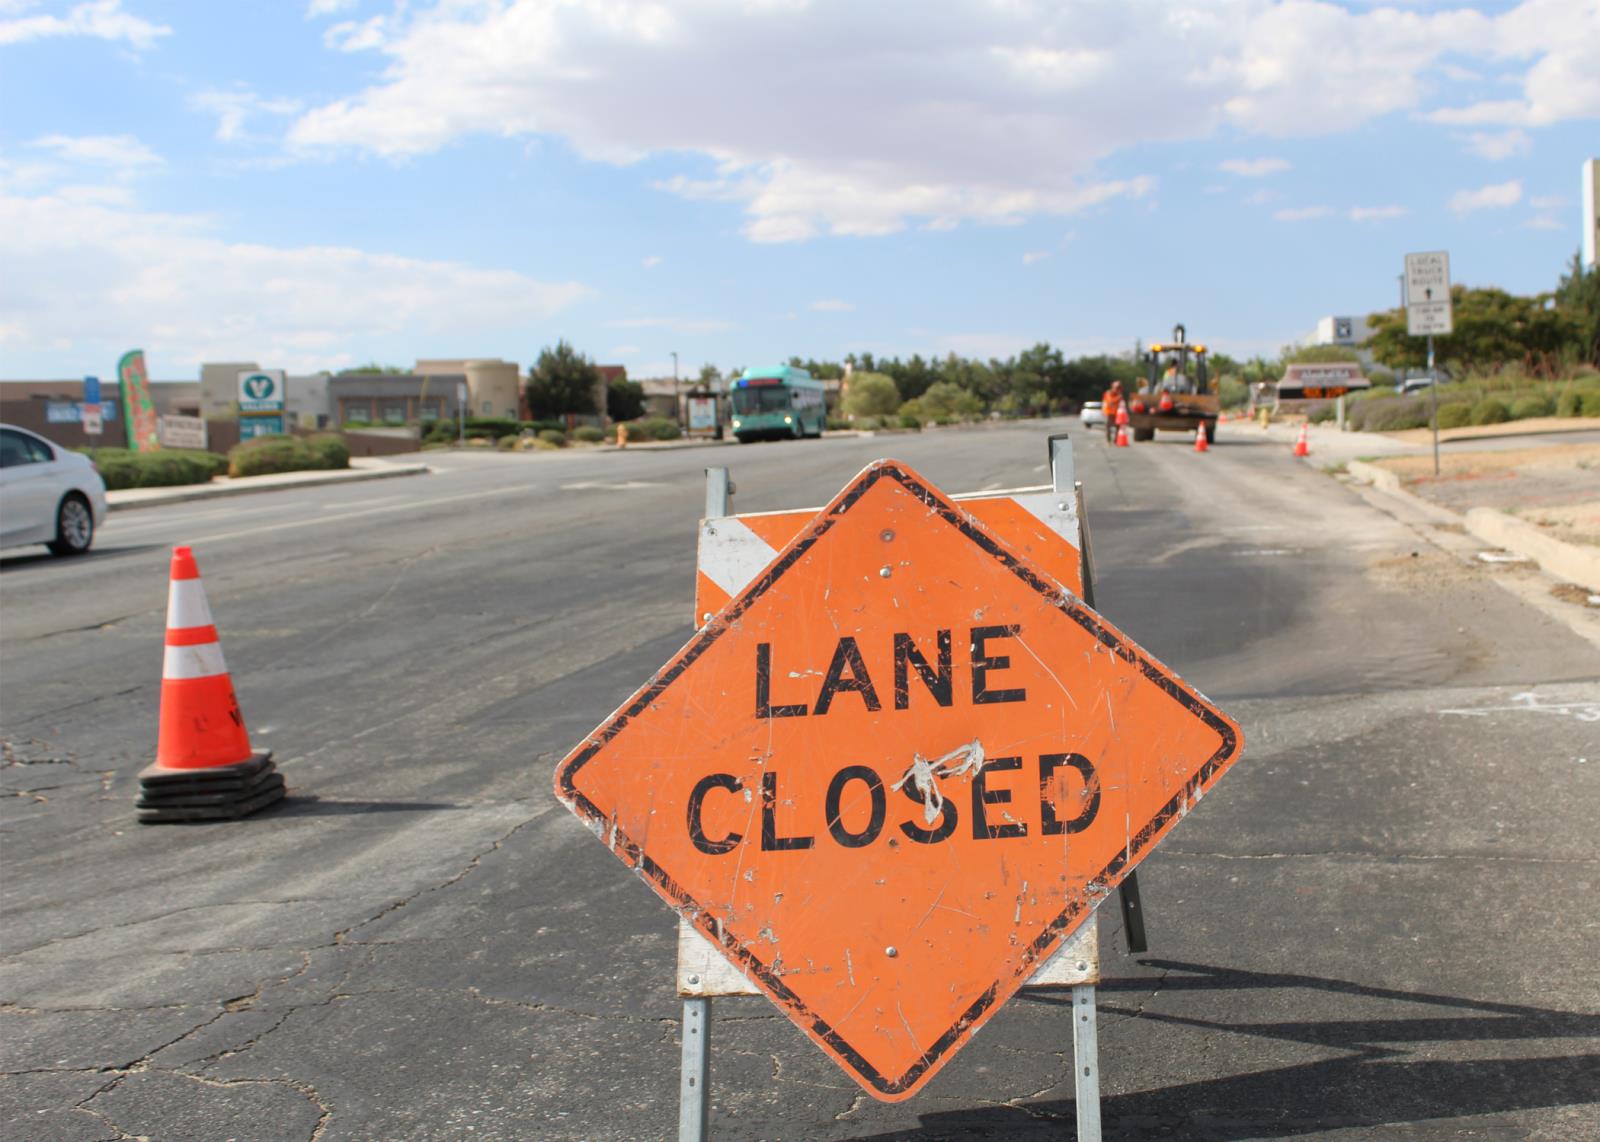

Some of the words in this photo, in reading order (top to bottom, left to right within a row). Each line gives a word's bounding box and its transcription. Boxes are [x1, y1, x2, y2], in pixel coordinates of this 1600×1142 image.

[1410, 255, 1442, 265] LOCAL
[1411, 266, 1443, 275] TRUCK
[1412, 276, 1443, 286] ROUTE
[755, 624, 1027, 719] LANE
[686, 753, 1101, 856] CLOSED
